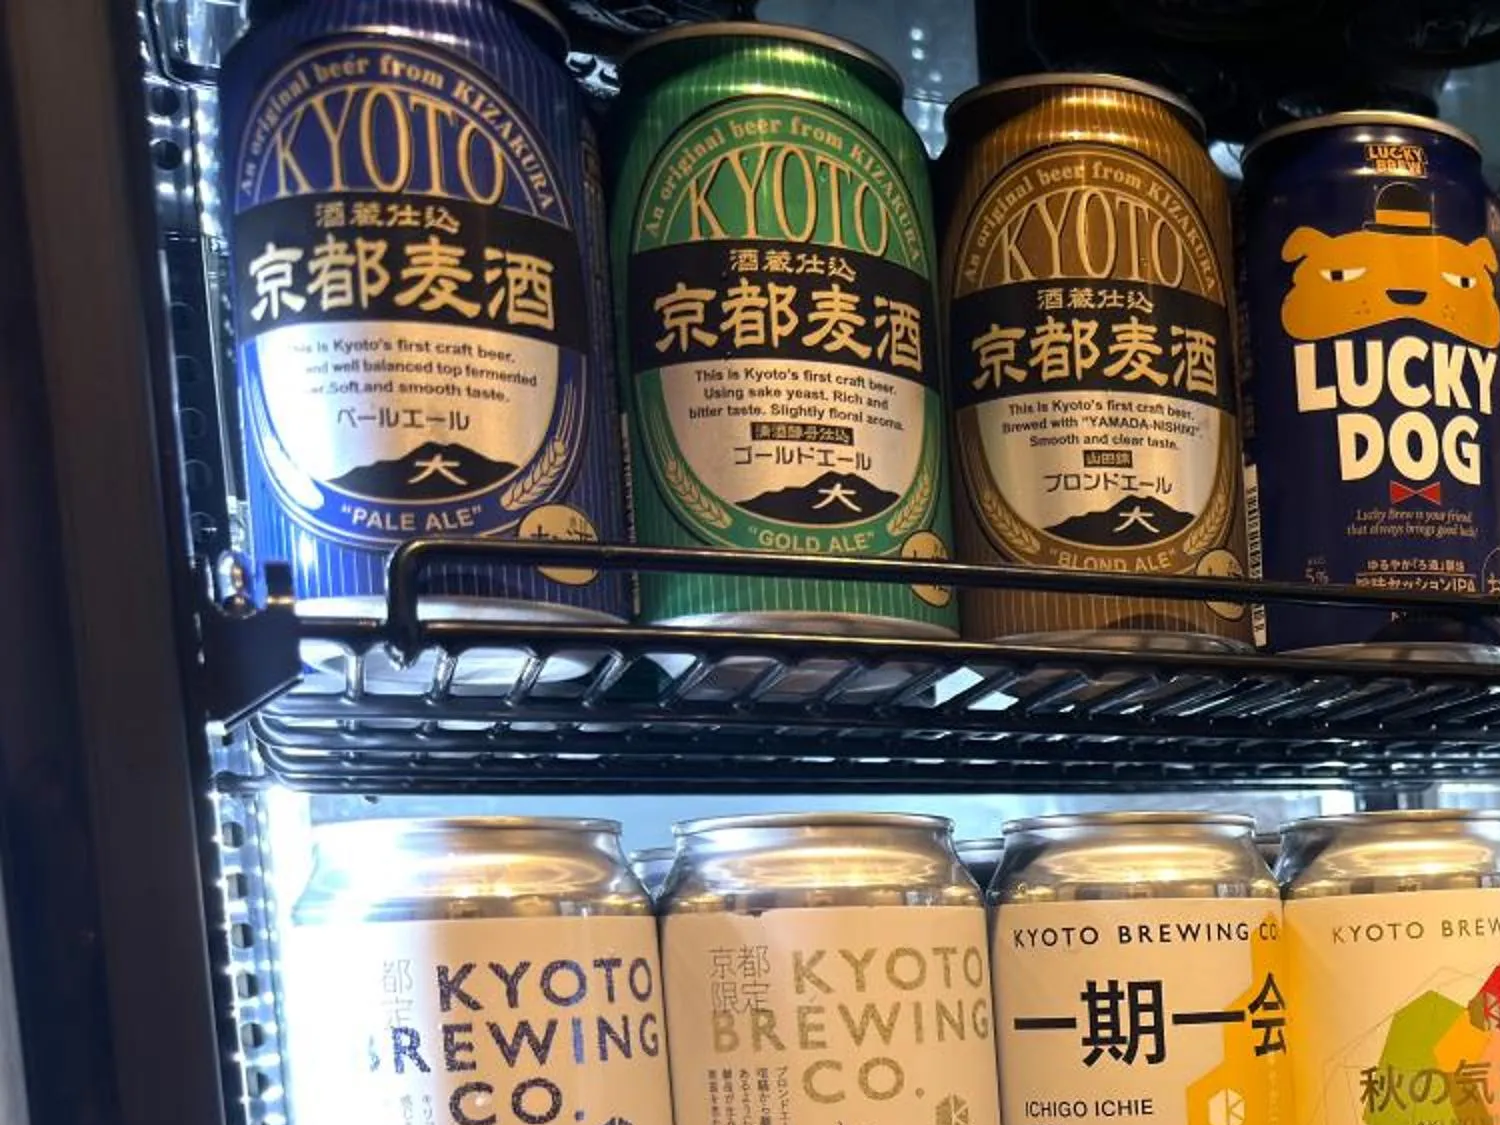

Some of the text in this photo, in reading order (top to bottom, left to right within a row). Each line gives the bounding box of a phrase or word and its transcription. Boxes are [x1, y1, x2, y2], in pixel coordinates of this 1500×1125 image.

[272, 84, 506, 206] KYOTO
[313, 52, 556, 212] beer from KIZAKURA
[729, 116, 844, 150] beer from
[1367, 146, 1424, 162] LUCKY
[1036, 161, 1085, 184] beer
[1091, 161, 1143, 191] from
[688, 142, 890, 257] KYOTO
[315, 201, 461, 236] 酒蔵仕込
[1002, 186, 1185, 289] KYOTO
[729, 249, 857, 282] 酒蔵仕込
[249, 236, 557, 332] 京都麦酒
[1036, 286, 1155, 313] 酒蔵仕込
[653, 277, 923, 373] 京都麦酒
[333, 338, 393, 354] Kyoto's
[397, 339, 431, 352] first
[436, 342, 473, 356] craft
[971, 316, 1218, 393] 京都麦酒
[333, 360, 537, 387] well balanced top fermented
[399, 382, 461, 398] smooth
[696, 369, 725, 383] This
[744, 367, 799, 383] Kyoto's
[803, 370, 832, 384] first
[835, 374, 866, 389] craft
[1294, 336, 1498, 415] LUCKY
[703, 388, 745, 402] Using
[749, 387, 781, 399] sake
[833, 390, 863, 405] Rich
[866, 395, 889, 410] and
[771, 403, 825, 421] Slightly
[829, 407, 863, 423] floral
[1009, 402, 1034, 416] This
[1052, 399, 1103, 414] Kyoto's
[1107, 399, 1133, 411] first
[1002, 414, 1079, 434] Brewed with
[1029, 431, 1144, 448] Smooth and clear
[733, 446, 872, 472] ゴールドエール
[1336, 411, 1481, 486] DOG
[1043, 472, 1174, 495] ブロンドエール
[1013, 921, 1250, 948] KYOTO BREWING
[1332, 921, 1425, 944] KYOTO
[708, 944, 771, 980] 京都
[792, 946, 984, 995] KYOTO
[436, 957, 653, 1013] KYOTO
[712, 997, 991, 1053] BREWING
[1013, 972, 1287, 1067] 一期一会
[802, 1056, 926, 1104] CO.
[1025, 1098, 1154, 1118] ICHIGO ICHIE
